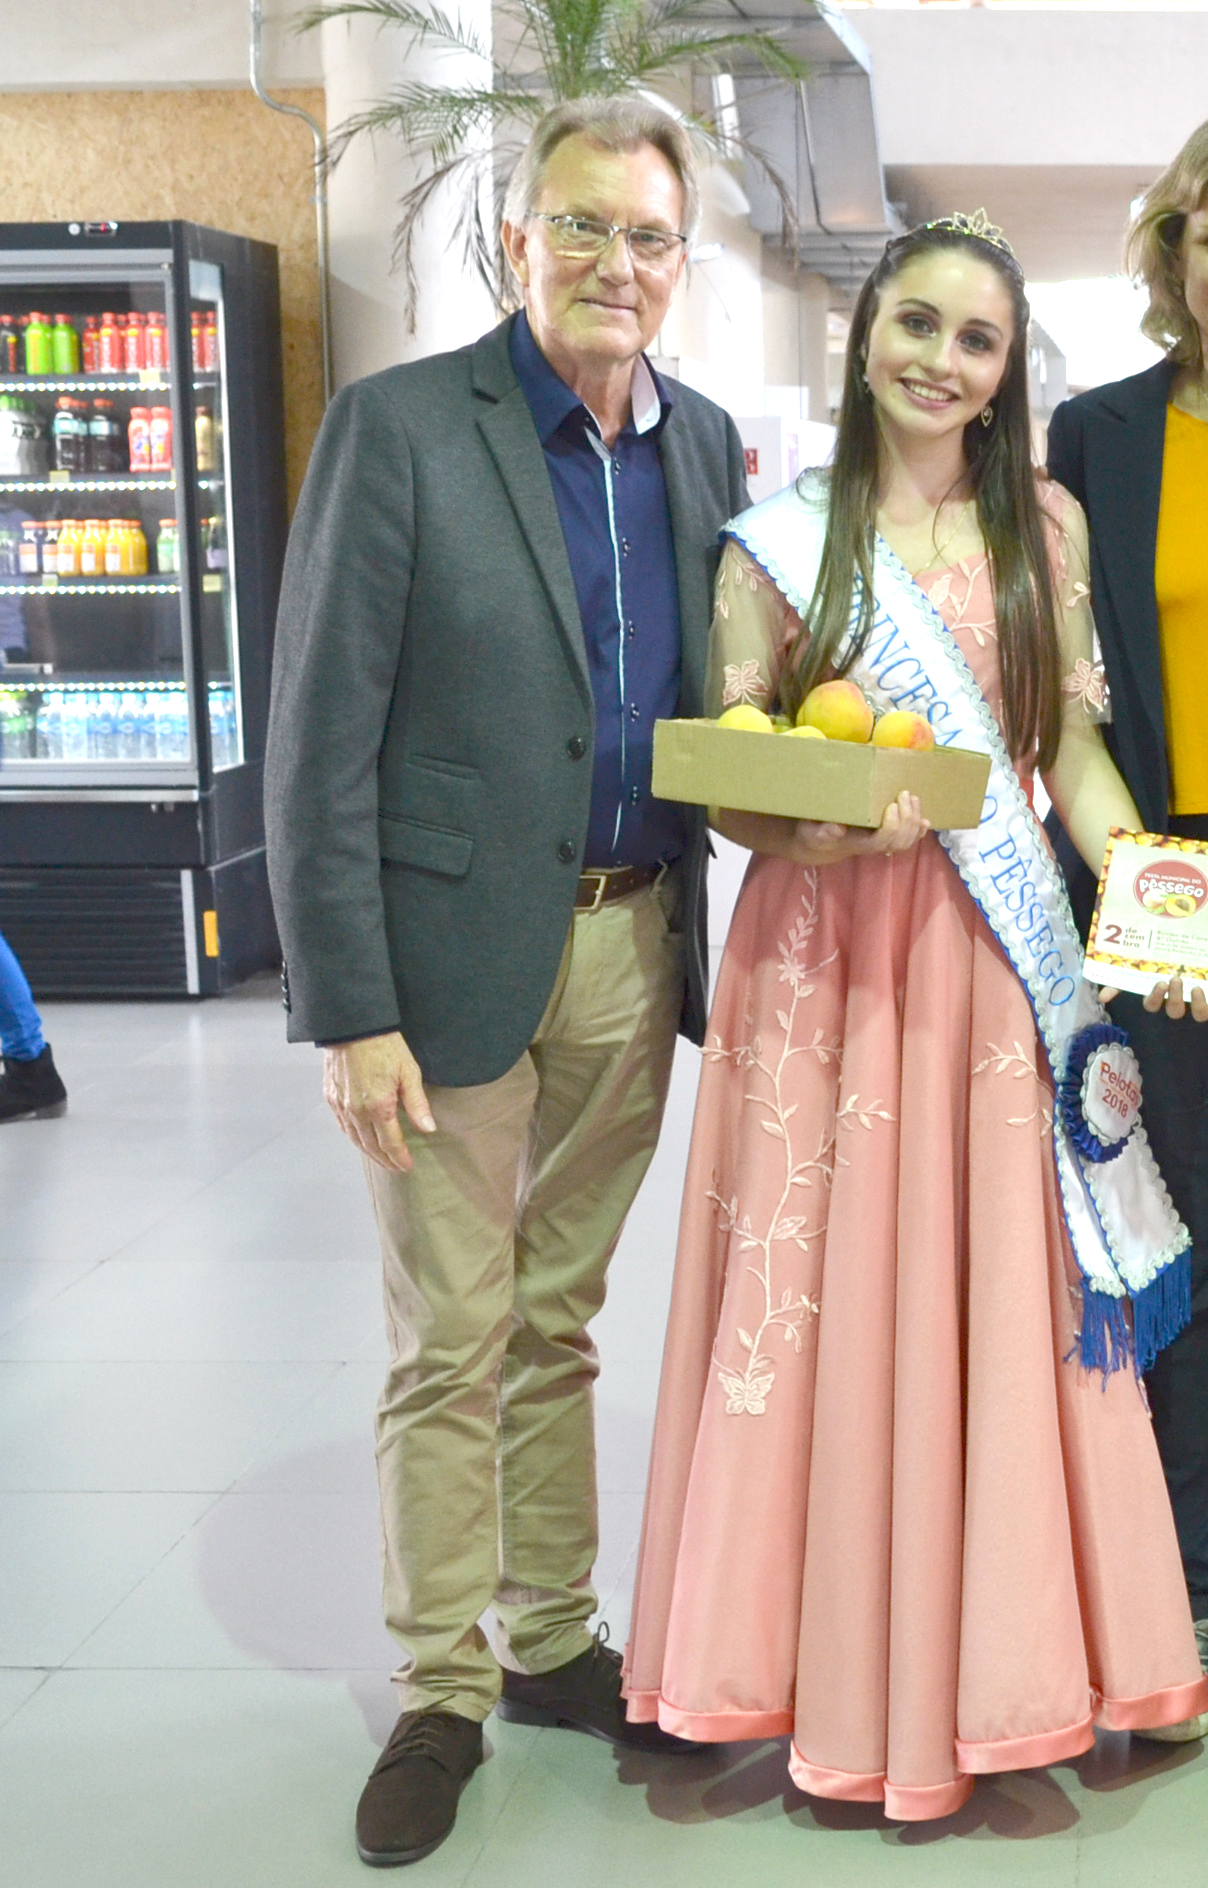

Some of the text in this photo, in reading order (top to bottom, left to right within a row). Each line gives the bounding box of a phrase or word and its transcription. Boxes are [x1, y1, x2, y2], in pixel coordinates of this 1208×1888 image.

[978, 832, 1076, 1006] PÊSSEGO
[1103, 924, 1122, 944] 2
[1125, 926, 1138, 934] de
[1123, 939, 1140, 948] bro
[1102, 1088, 1129, 1118] 2018
